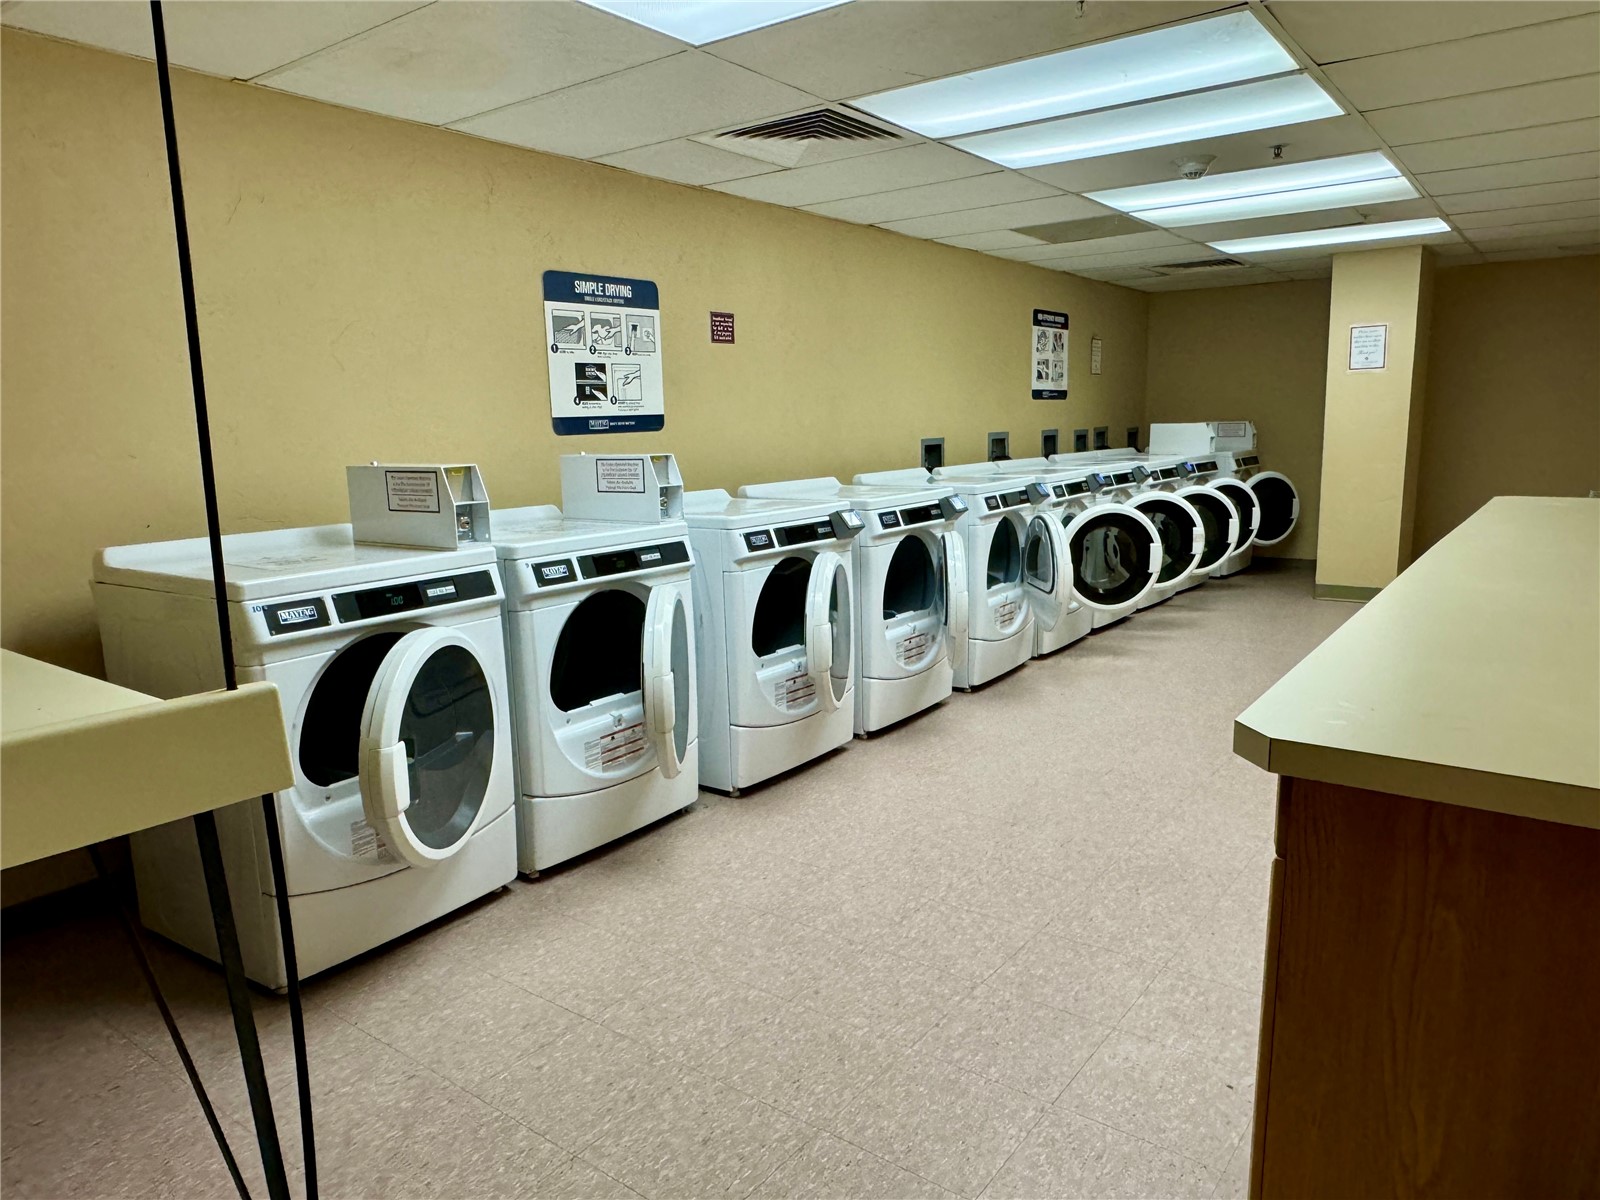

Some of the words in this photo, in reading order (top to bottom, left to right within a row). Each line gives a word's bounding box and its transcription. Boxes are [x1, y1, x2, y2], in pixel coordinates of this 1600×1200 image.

[574, 280, 604, 295] SIMPLE
[605, 283, 632, 298] DRYING
[251, 605, 262, 613] 10
[280, 607, 315, 620] MAYTAG
